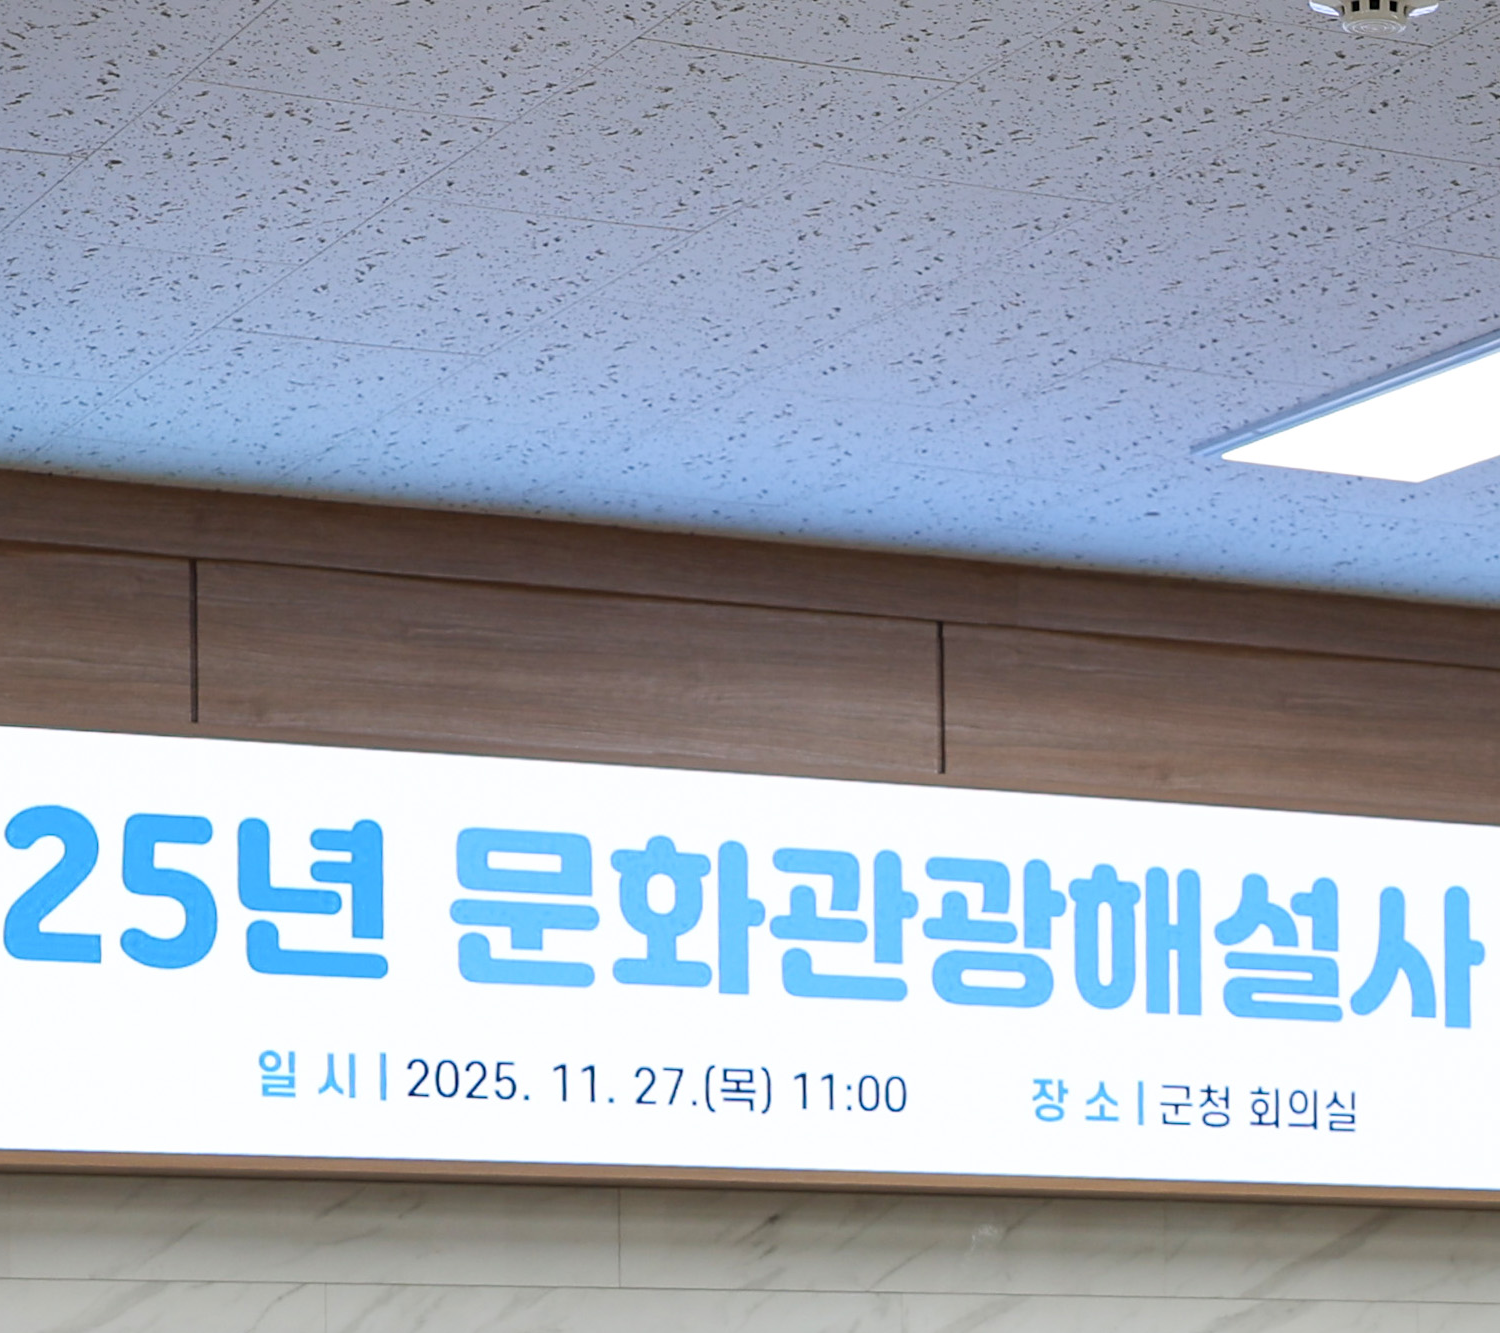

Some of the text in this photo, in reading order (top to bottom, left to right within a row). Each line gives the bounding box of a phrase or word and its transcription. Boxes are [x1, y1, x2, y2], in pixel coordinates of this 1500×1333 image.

[449, 825, 1485, 1029] 문화관광해설사
[406, 1057, 530, 1101] 2025.
[552, 1063, 615, 1103] 11.
[634, 1064, 772, 1115] 27.(목)
[793, 1071, 908, 1114] 11:00
[1159, 1084, 1231, 1128] 군청
[1249, 1086, 1356, 1133] 회의실
